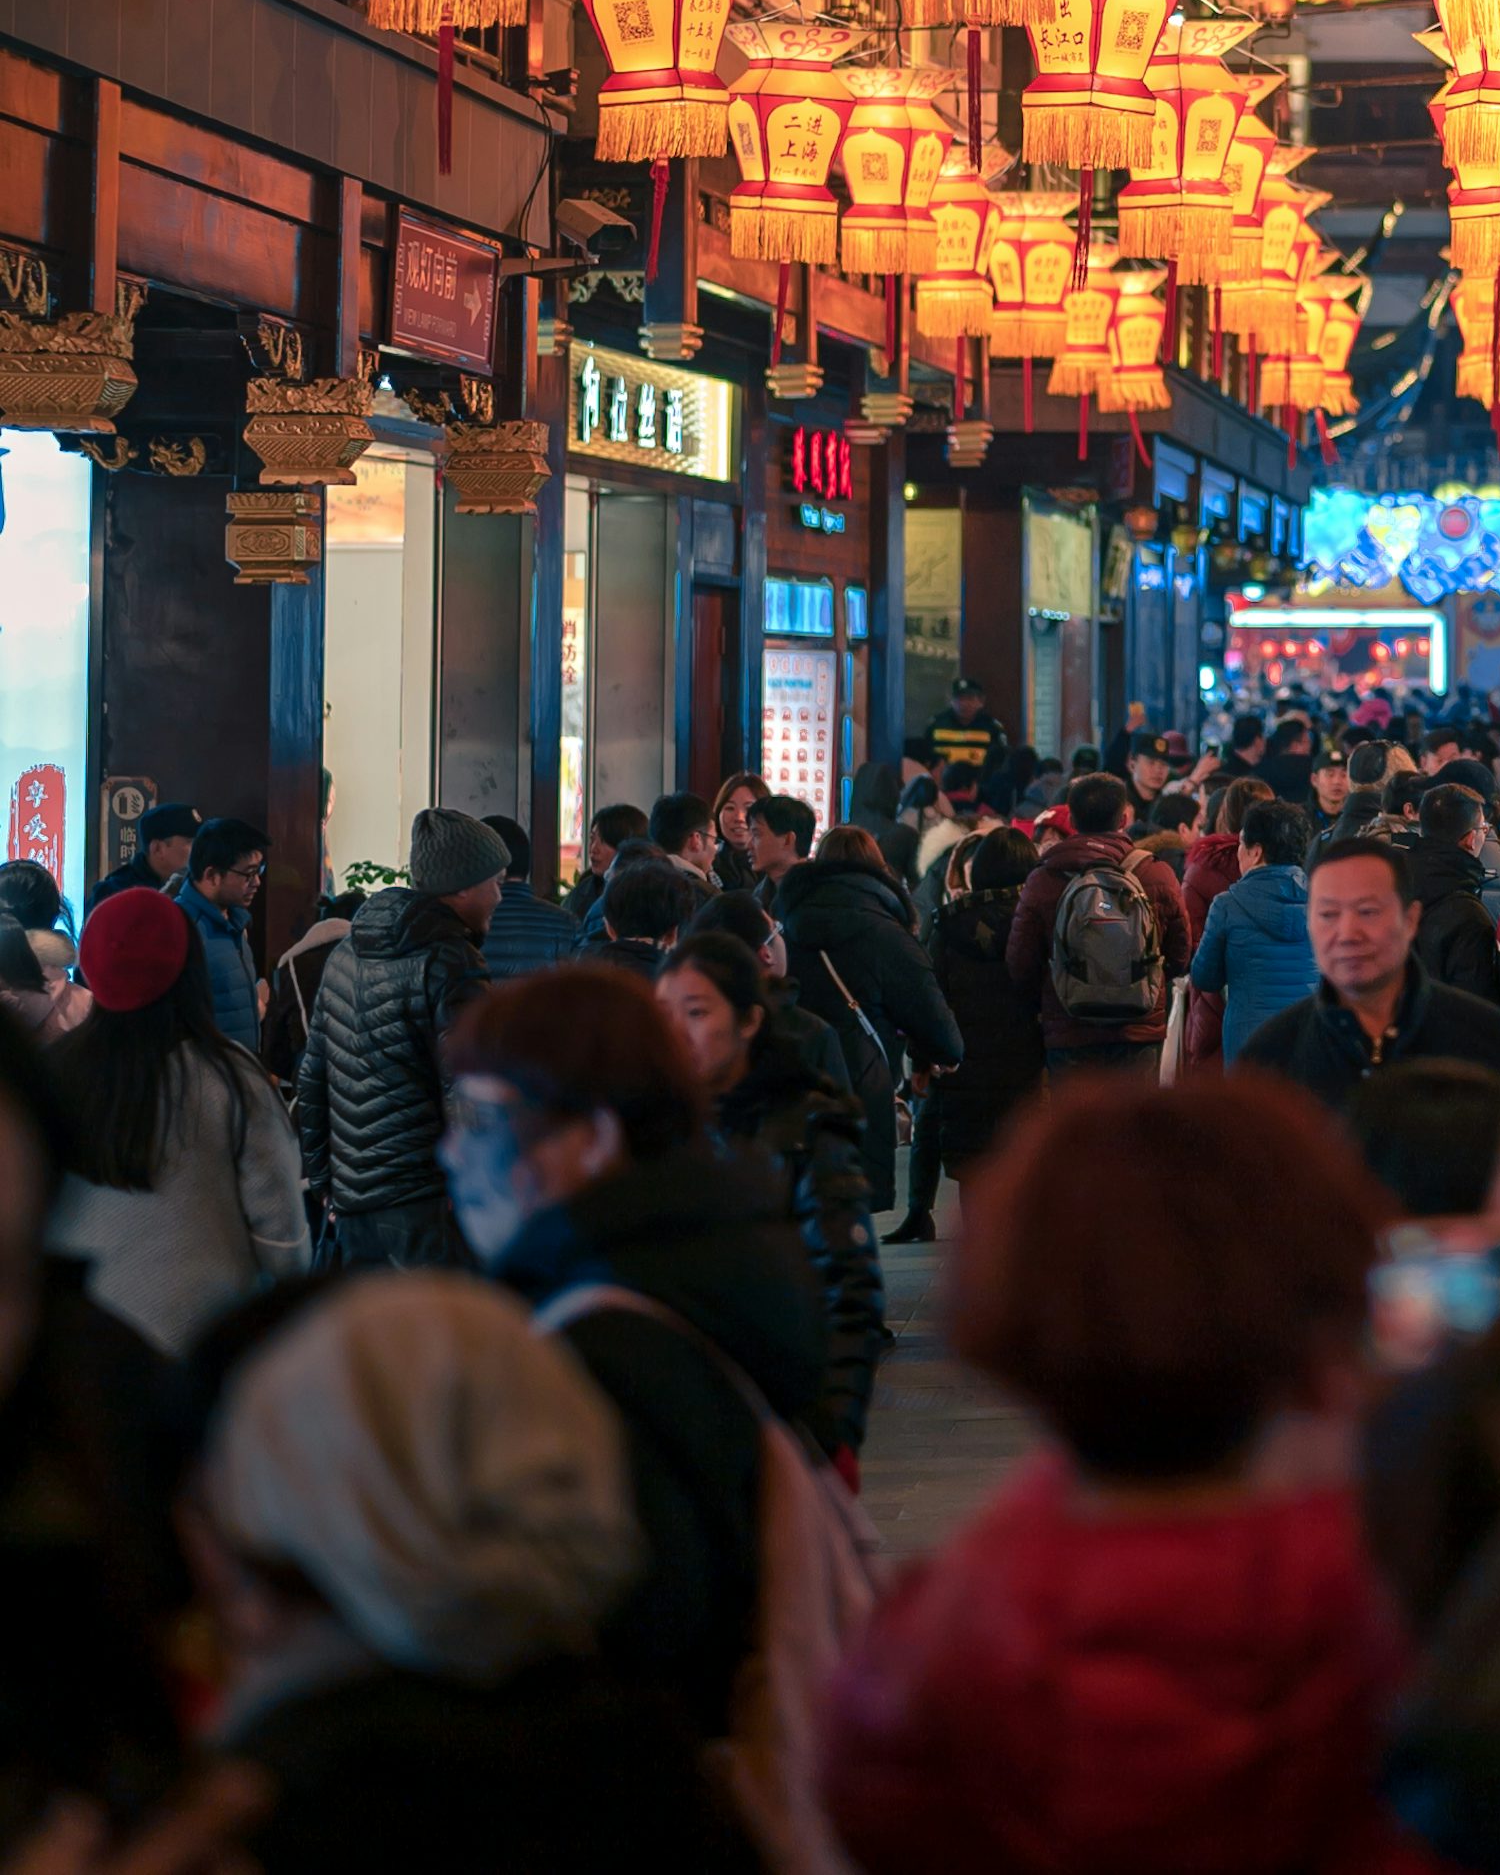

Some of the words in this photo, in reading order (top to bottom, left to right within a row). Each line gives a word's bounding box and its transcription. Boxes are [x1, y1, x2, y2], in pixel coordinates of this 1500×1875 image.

[1040, 27, 1084, 50] 长江口
[406, 241, 458, 301] 观灯向前
[119, 827, 137, 866] 临时
